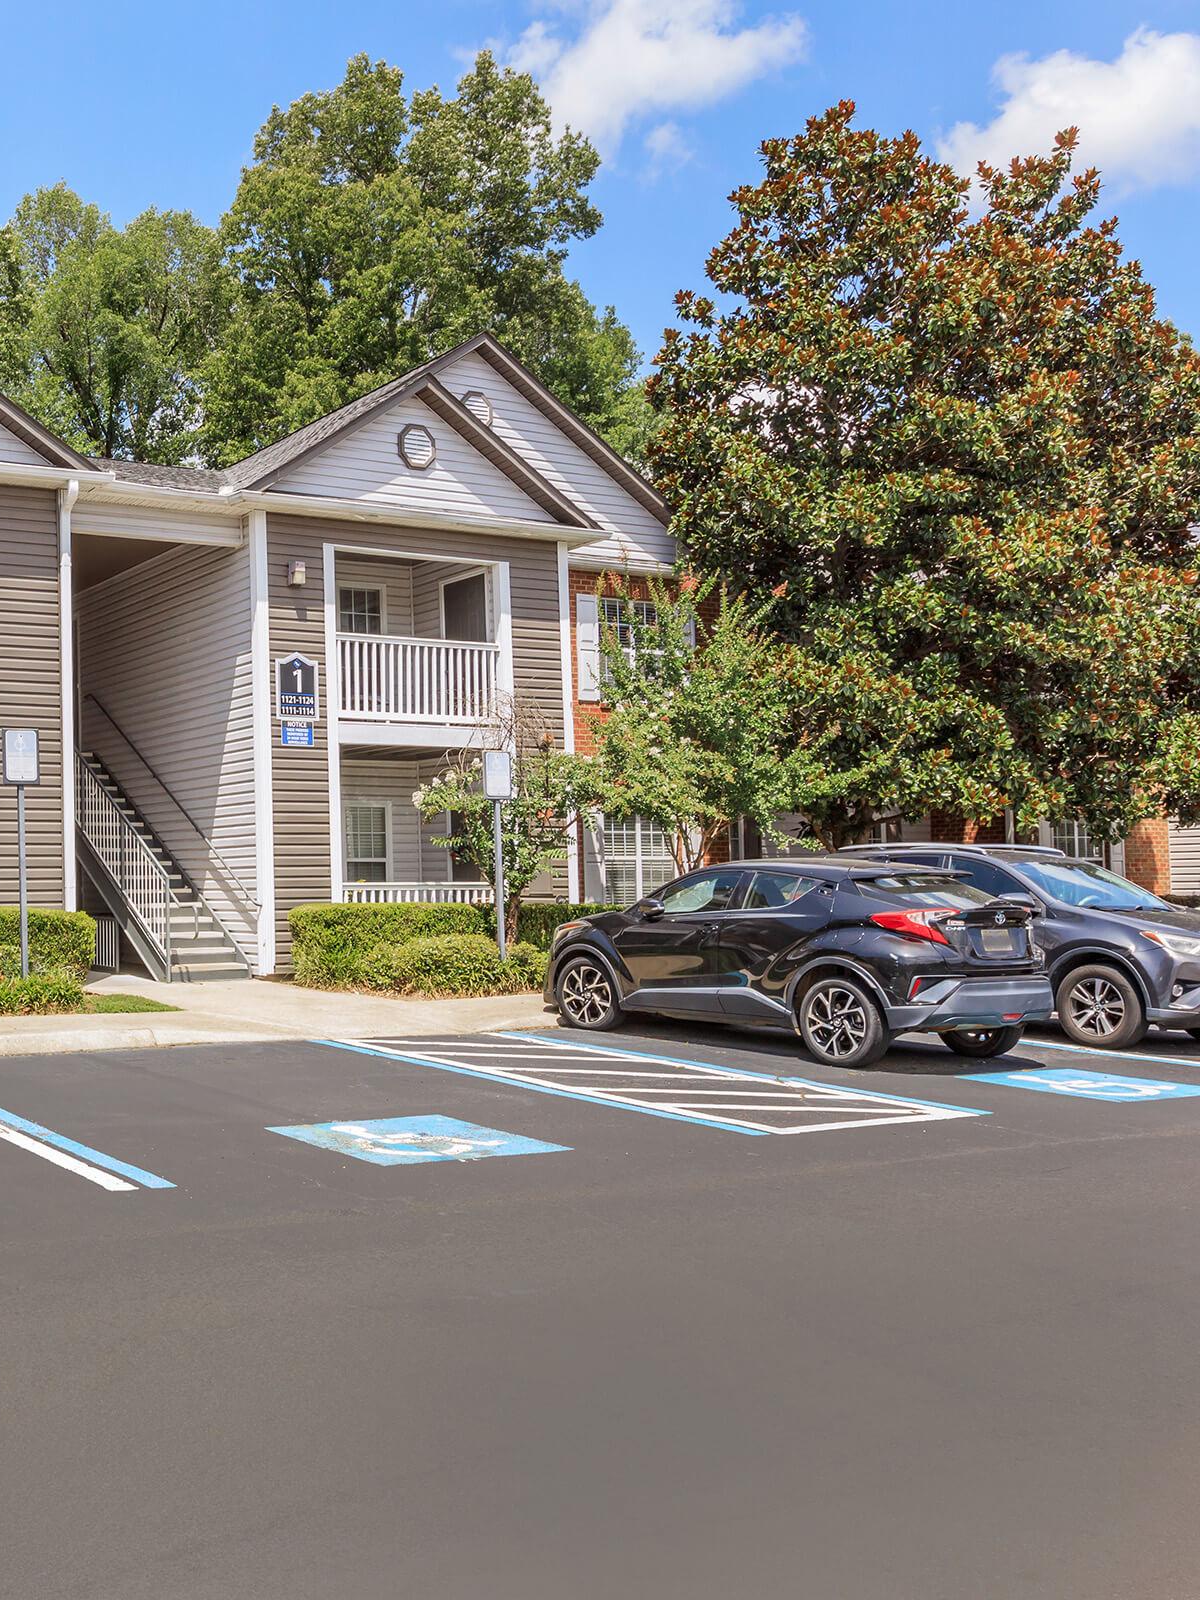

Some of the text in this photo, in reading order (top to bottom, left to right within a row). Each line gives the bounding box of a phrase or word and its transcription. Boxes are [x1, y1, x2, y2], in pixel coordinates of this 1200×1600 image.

[293, 669, 303, 693] 1
[281, 695, 314, 705] 1121-1124
[281, 706, 315, 716] 1111-1114
